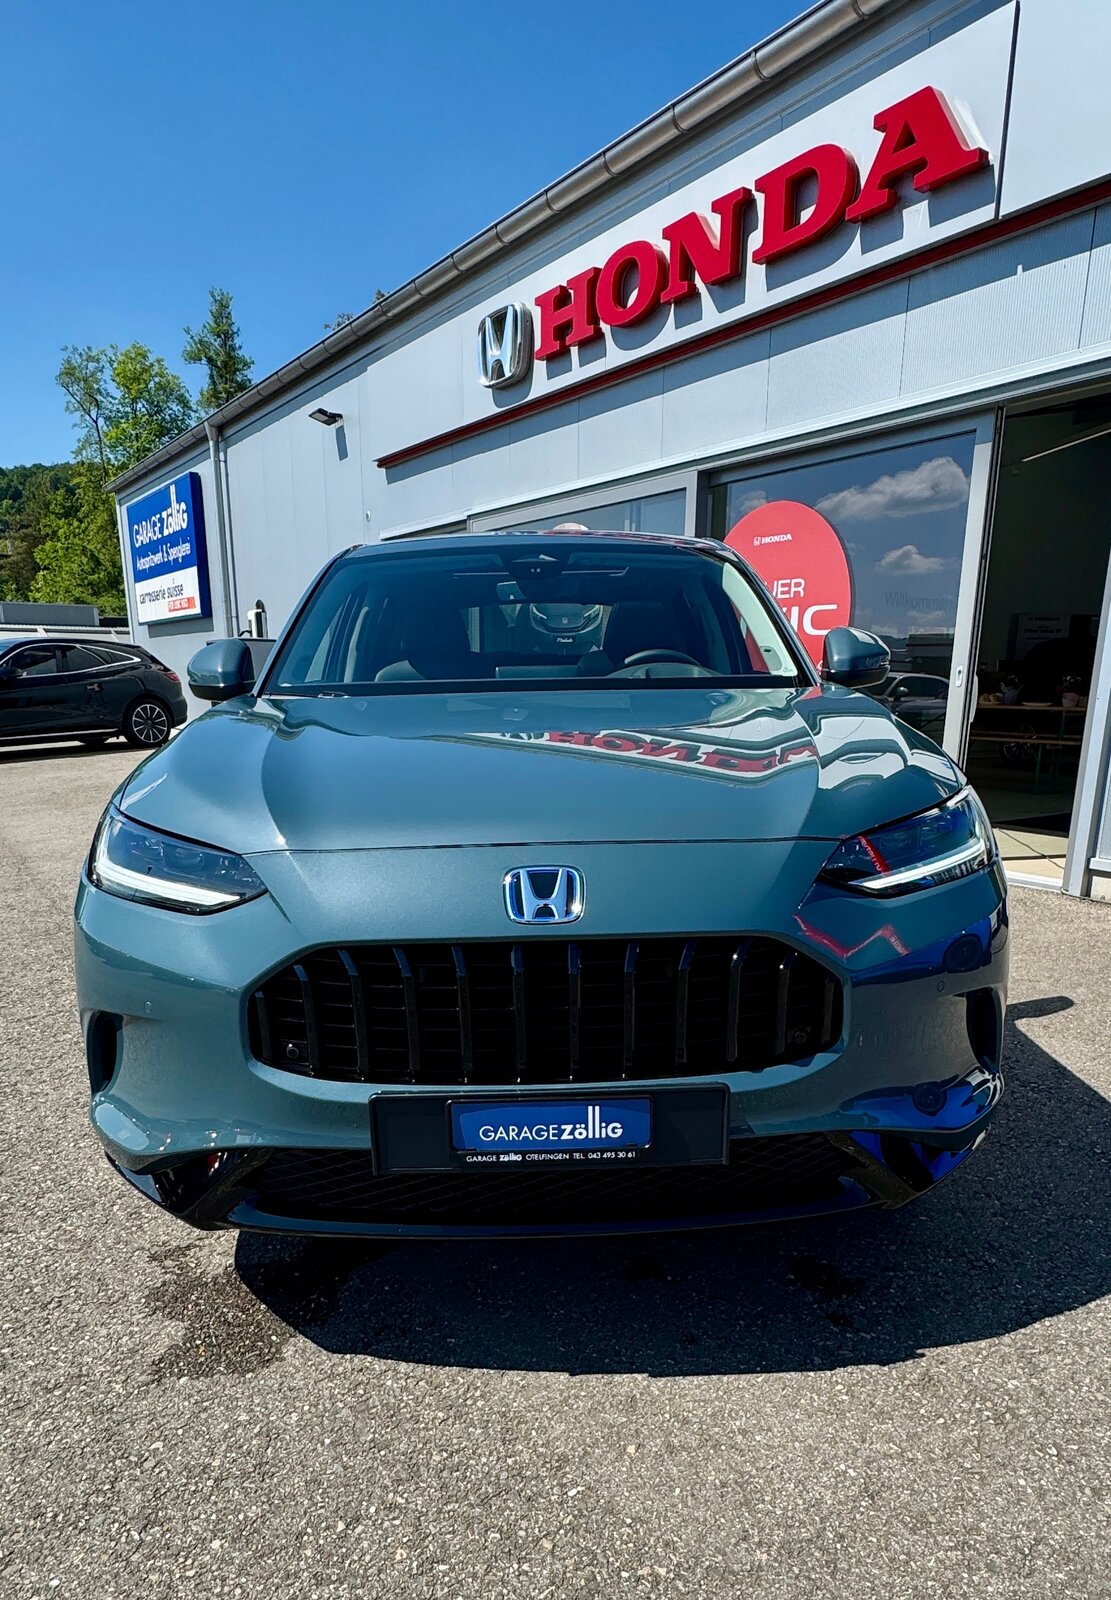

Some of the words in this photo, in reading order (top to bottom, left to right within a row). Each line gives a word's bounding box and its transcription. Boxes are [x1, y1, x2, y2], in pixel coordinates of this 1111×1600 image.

[534, 86, 990, 362] HONDA
[133, 513, 162, 548] GARAGE
[761, 533, 793, 543] HONDA
[162, 544, 168, 562] &
[167, 537, 191, 566] Spenglerei
[139, 584, 166, 605] carrosserie
[167, 579, 184, 599] suisse
[885, 591, 953, 610] Willkommen
[479, 1124, 558, 1141] GARAGE
[525, 1152, 570, 1161] OTELFINGEN
